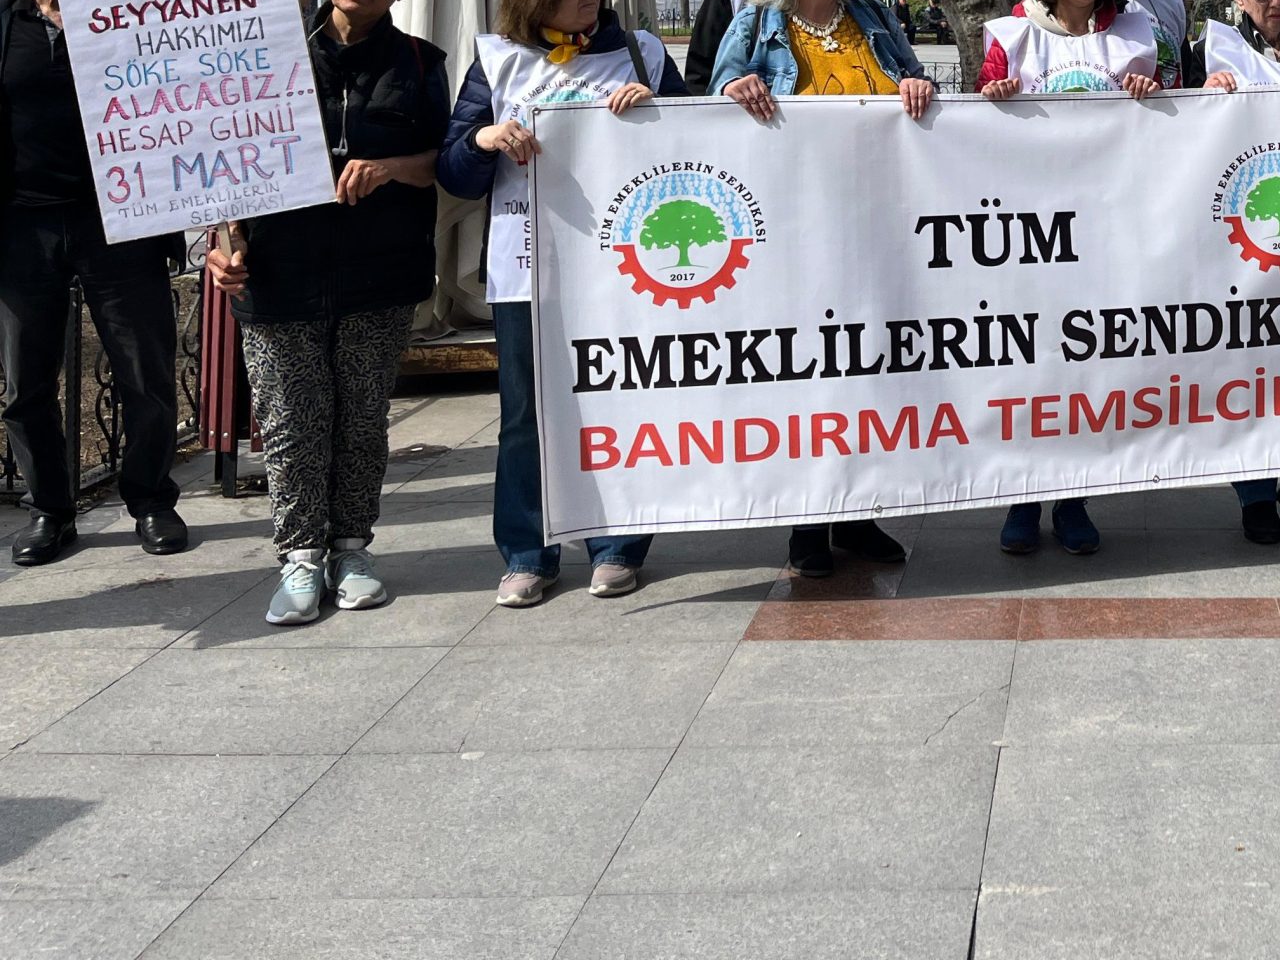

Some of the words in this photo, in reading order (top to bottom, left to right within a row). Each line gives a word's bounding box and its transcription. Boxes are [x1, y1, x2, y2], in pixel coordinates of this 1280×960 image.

[135, 16, 265, 56] HAKKIMIZI
[104, 57, 182, 92] SÖKE
[199, 47, 271, 76] SÖKE
[97, 120, 193, 156] HESAP
[210, 102, 295, 141] GÜNÜ
[106, 161, 146, 203] 31
[172, 136, 301, 191] MART
[118, 203, 158, 218] TÜM
[598, 218, 613, 251] TÜM
[607, 161, 714, 214] EMEKLİLERİN
[717, 170, 766, 243] SENDİKASI
[914, 197, 1080, 269] TÜM
[1211, 192, 1223, 222] TÜM
[670, 273, 695, 282] 2017
[571, 299, 1040, 394] EMEKLİLERİN
[578, 401, 970, 472] BANDIRMA
